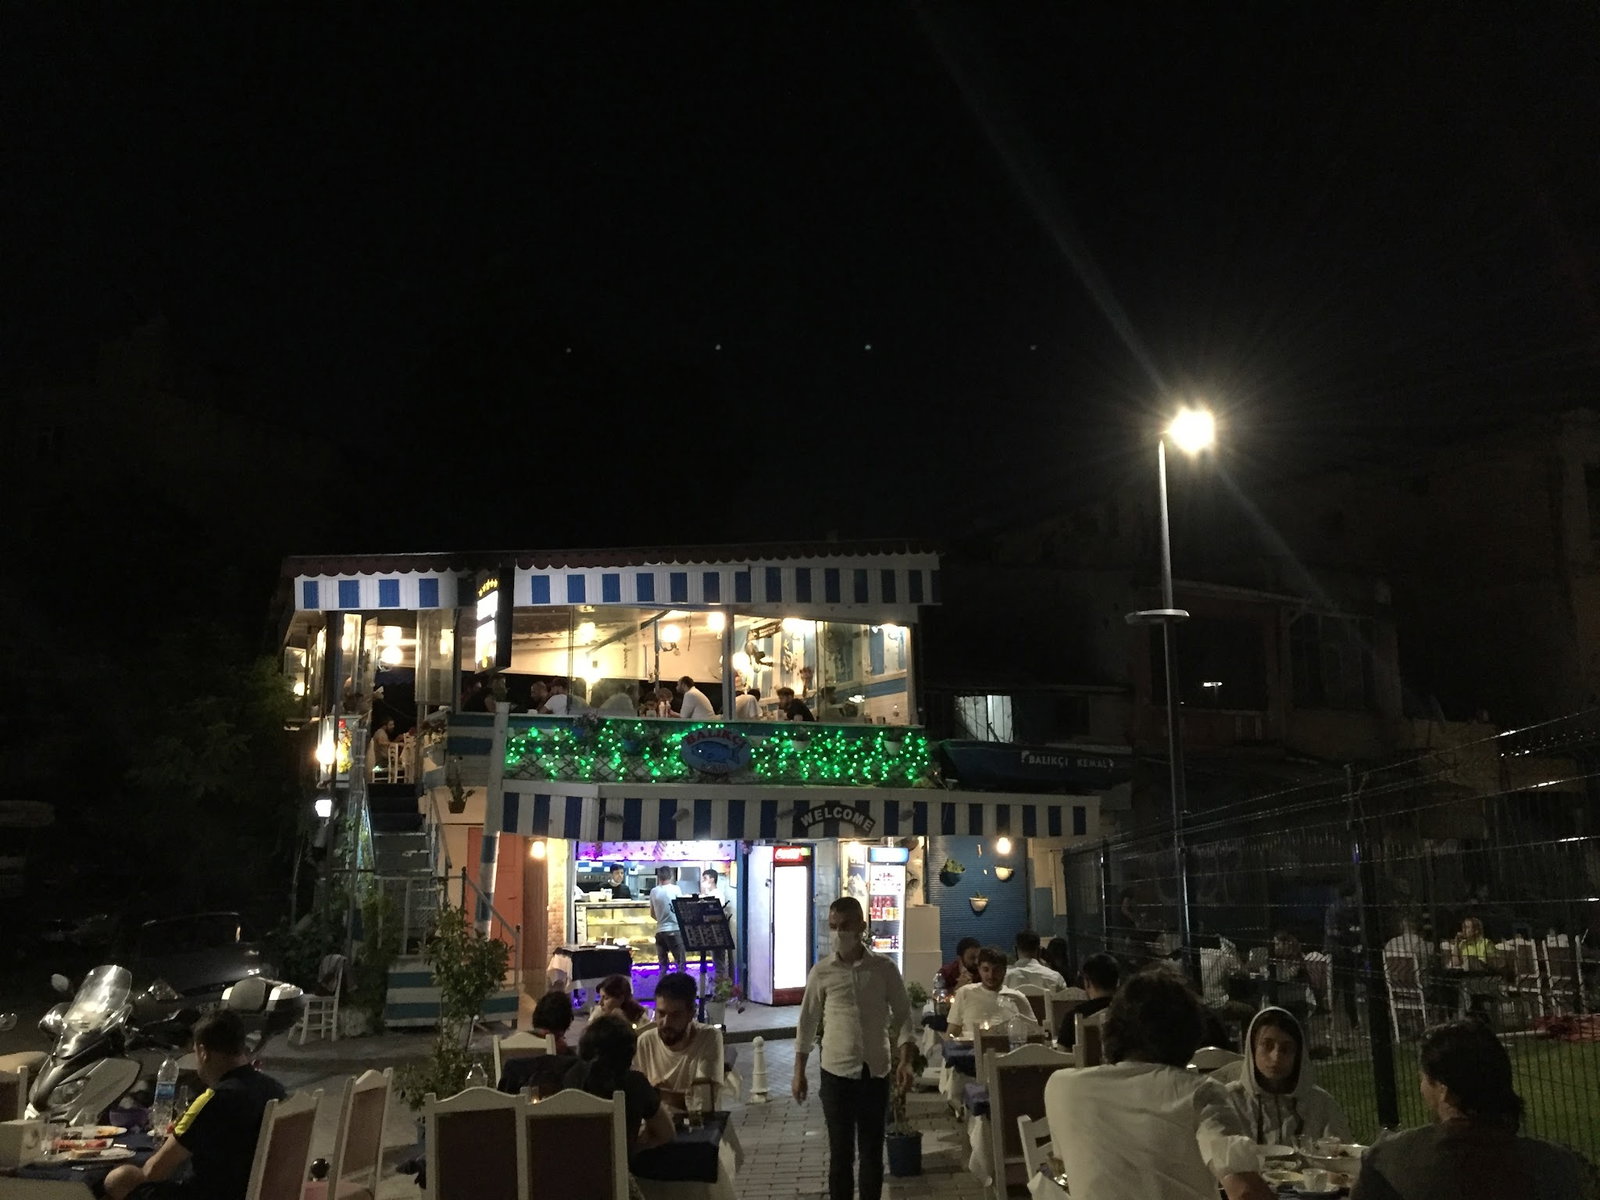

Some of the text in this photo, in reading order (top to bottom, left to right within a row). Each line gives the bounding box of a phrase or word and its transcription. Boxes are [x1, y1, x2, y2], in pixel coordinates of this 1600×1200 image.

[1028, 754, 1107, 769] BALIKÇI KEMAL
[800, 806, 874, 832] WELCOME
